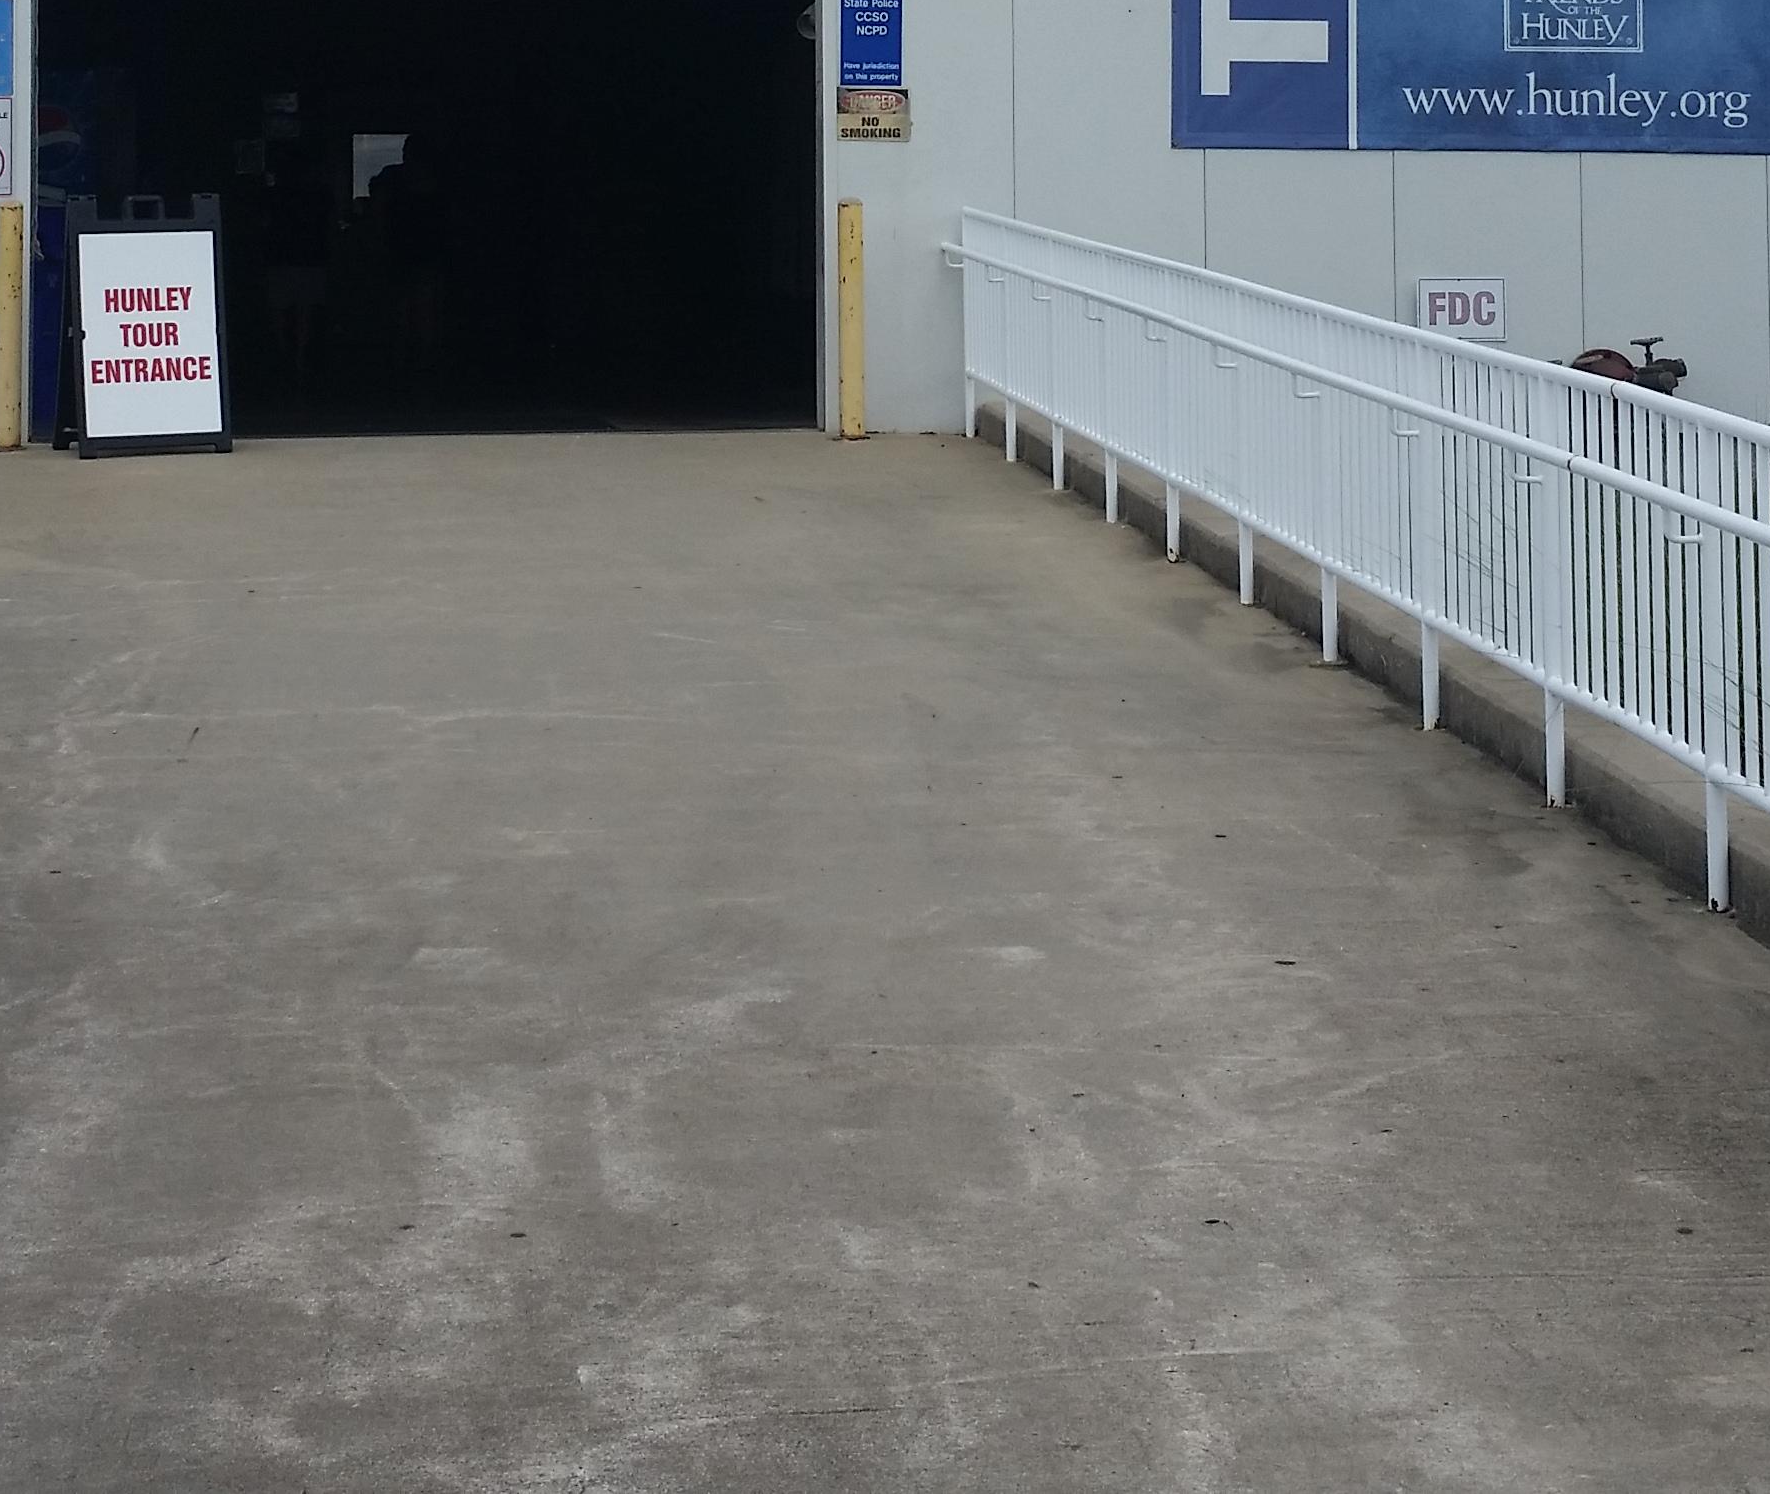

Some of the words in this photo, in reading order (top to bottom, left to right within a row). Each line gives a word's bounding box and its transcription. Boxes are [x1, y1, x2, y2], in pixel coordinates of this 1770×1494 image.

[855, 11, 889, 22] CCSO
[1521, 12, 1630, 46] HUNLEY
[856, 25, 888, 36] NCPD
[869, 73, 899, 81] property
[1402, 72, 1751, 128] www.hunley.org
[841, 127, 901, 138] SMOKING
[861, 116, 880, 127] NO
[104, 286, 192, 313] HUNLEY
[1428, 290, 1497, 326] FDC
[119, 322, 179, 347] TOUR
[91, 356, 213, 384] ENTRANCE
